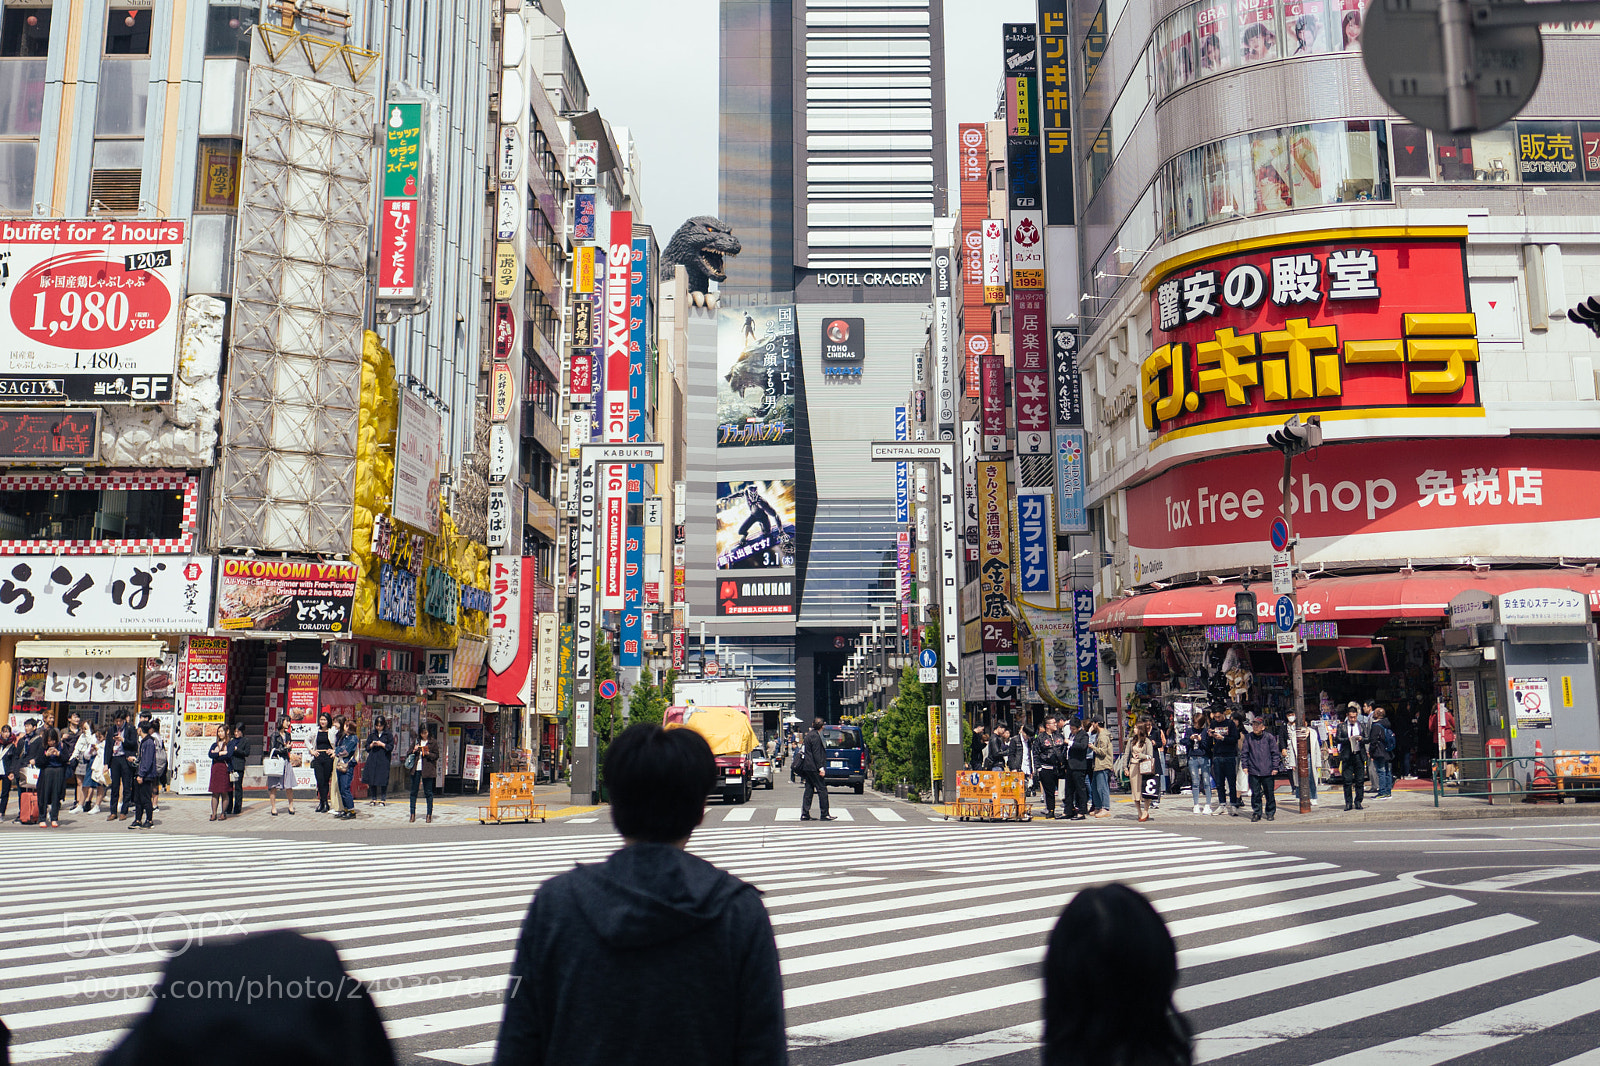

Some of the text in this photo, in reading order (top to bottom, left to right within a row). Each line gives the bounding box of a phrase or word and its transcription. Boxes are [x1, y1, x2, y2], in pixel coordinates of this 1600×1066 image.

[1044, 12, 1068, 154] ドン・キホーテ
[388, 145, 417, 157] サラダ
[1520, 133, 1575, 160] 販売
[387, 161, 418, 173] スイーツ
[501, 171, 515, 179] 6F
[1018, 198, 1034, 207] 7F
[3, 223, 179, 241] buffet for 2 hours
[390, 210, 411, 285] ひょうたん
[128, 252, 169, 271] 120分
[499, 257, 515, 285] 虎の子
[816, 272, 926, 286] HOTEL GRACERY
[1157, 249, 1382, 332] 驚安の殿堂
[608, 243, 631, 358] SHIDAX
[29, 291, 156, 337] 1,980 yen
[826, 345, 848, 353] TOHO
[1022, 314, 1041, 368] 居楽屋
[73, 352, 119, 370] 1,480
[826, 351, 856, 359] CINEMAS
[824, 367, 862, 376] IMAX
[130, 377, 168, 399] 5F
[1018, 374, 1048, 429] 笑笑
[609, 402, 625, 433] BIC
[718, 420, 794, 447] ブラックパンサー
[875, 447, 941, 456] CENTRAL ROAD
[1064, 464, 1073, 499] STAGE
[1072, 464, 1081, 494] IDOL
[985, 465, 1002, 539] きんくら酒場
[1165, 466, 1544, 532] Tax Free Shop 免税店
[490, 498, 504, 531] かっぱ
[1021, 498, 1046, 588] カラオケ
[225, 560, 357, 580] OKONOMI YAKI
[578, 480, 594, 659] GODZILLA ROAD
[762, 552, 780, 566] 3.1
[1141, 563, 1149, 575] Don
[276, 588, 297, 596] Drinks
[298, 588, 308, 596] for
[313, 589, 332, 597] hours
[492, 562, 509, 629] トラノコ
[624, 538, 639, 653] カラオケ館
[741, 582, 792, 597] MARUHAN
[982, 557, 1011, 619] 金の蔵
[1504, 598, 1580, 609] 安全安心ステーション
[298, 622, 331, 630] TORADYU
[1278, 604, 1287, 627] P
[1076, 594, 1093, 668] カラオケ
[190, 639, 228, 649] お好み焼き
[51, 671, 137, 694] とらそば
[188, 669, 226, 684] 2,500円
[1080, 670, 1096, 683] B1
